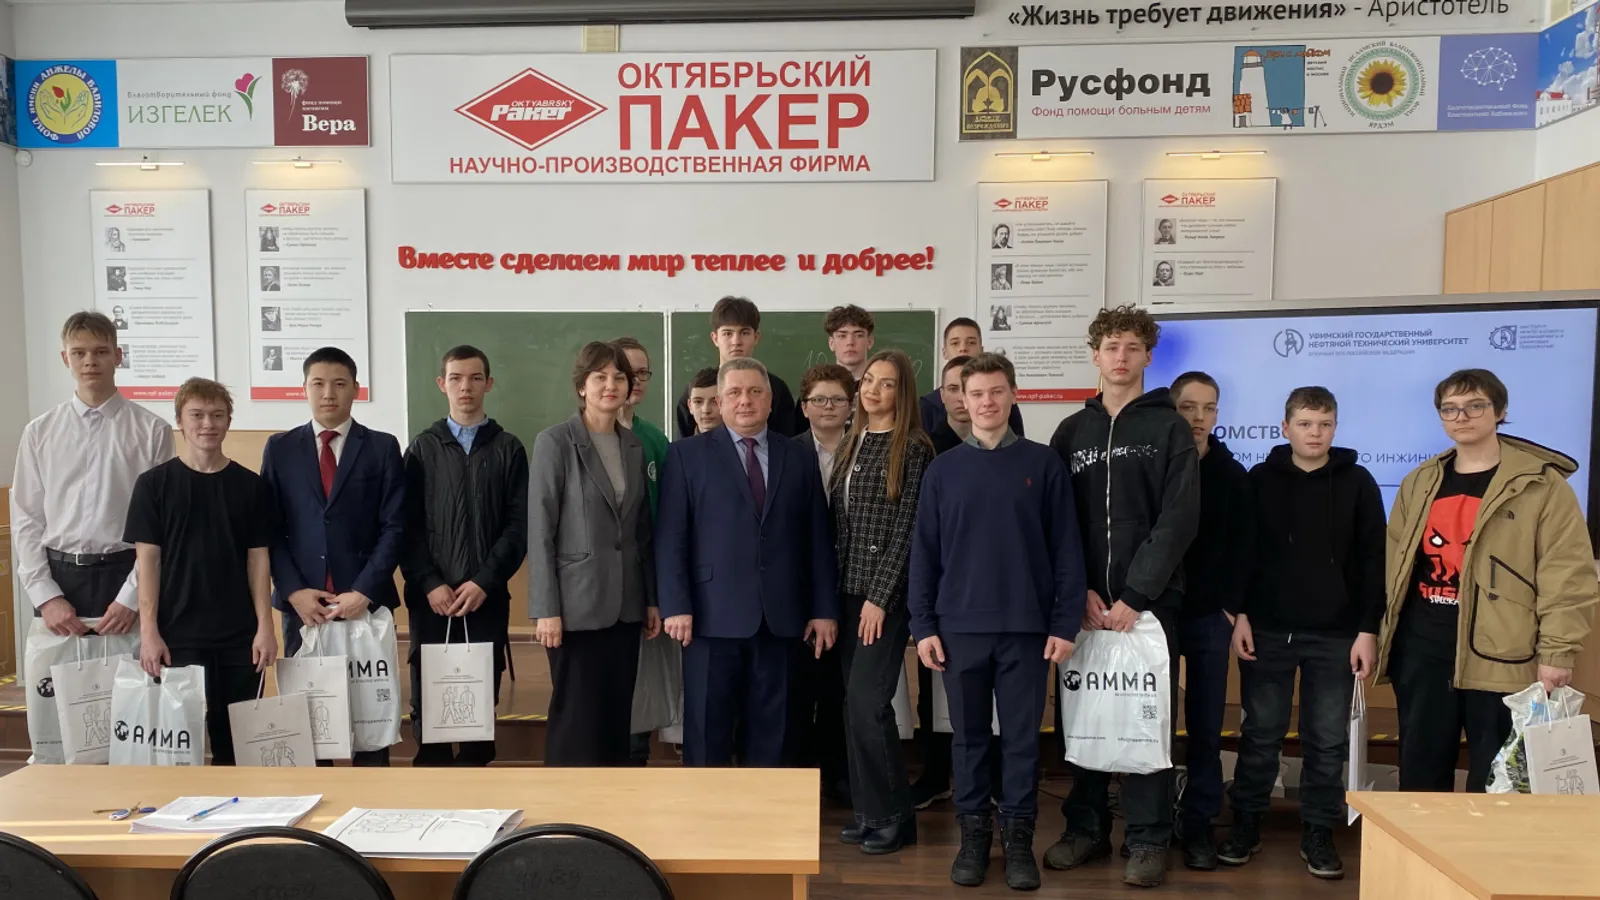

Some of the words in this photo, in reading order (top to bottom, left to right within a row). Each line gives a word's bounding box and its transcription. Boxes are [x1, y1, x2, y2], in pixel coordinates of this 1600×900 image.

[1008, 4, 1100, 26] «Жизнь
[1106, 2, 1201, 29] требует
[1206, 1, 1346, 25] движения»
[1367, 0, 1509, 22] Аристотель
[618, 54, 871, 89] ОКТЯБРЬСКИЙ
[1032, 68, 1210, 102] Русфонд
[128, 104, 232, 124] ИЗГЕЛЕК
[1031, 106, 1064, 117] Фонд
[1067, 106, 1115, 116] помощи
[1118, 104, 1172, 115] больным
[1174, 104, 1211, 115] детям
[302, 114, 356, 135] Вера
[619, 93, 870, 151] ПАКЕР
[450, 155, 782, 176] НАУЧНО-ПРОИЗВОДСТВЕННАЯ
[790, 155, 870, 173] ФИРМА
[1014, 200, 1048, 208] ПАКЕР
[1182, 196, 1216, 204] ПАКЕР
[398, 246, 494, 270] Вместе
[500, 253, 621, 274] сделаем
[628, 254, 684, 277] мир
[691, 254, 786, 271] теплее
[797, 254, 816, 271] и
[822, 246, 935, 277] добрее!
[1309, 331, 1354, 340] УФИМСКИЙ
[1355, 329, 1432, 338] ГОСУДАРСТВЕННЫЙ
[1309, 340, 1352, 348] НЕФТЯНОЙ
[1353, 338, 1410, 347] ТЕХНИЧЕСКИЙ
[1412, 338, 1468, 346] УНИВЕРСИТЕТ
[1086, 672, 1156, 692] AMMA
